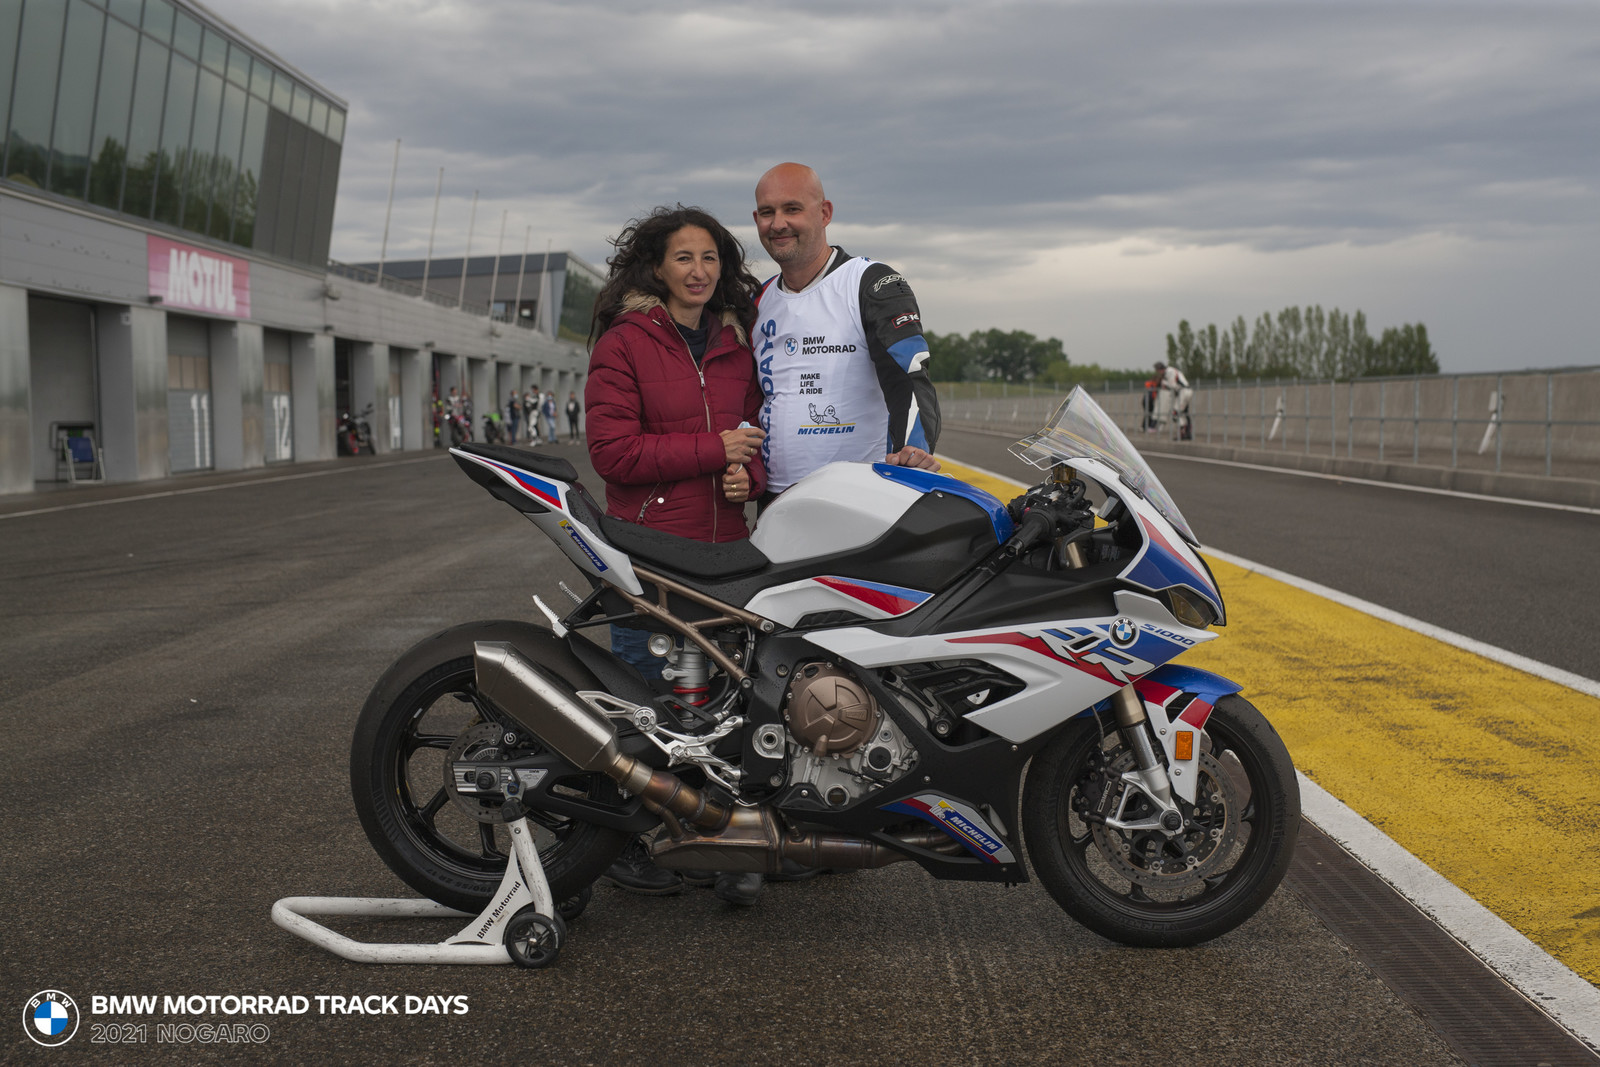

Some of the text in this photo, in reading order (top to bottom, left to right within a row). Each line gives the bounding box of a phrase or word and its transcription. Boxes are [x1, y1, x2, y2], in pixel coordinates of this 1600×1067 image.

[167, 249, 236, 311] MOTUL
[760, 319, 776, 395] DAYS
[802, 336, 825, 345] BMW
[802, 344, 857, 355] MOTORRAD
[190, 393, 211, 469] 11
[273, 395, 291, 460] 12
[797, 426, 855, 435] MICHELIN
[572, 535, 602, 566] MICHELIN
[950, 815, 999, 850] MICHELIN
[476, 880, 521, 940] BMW Motorrad
